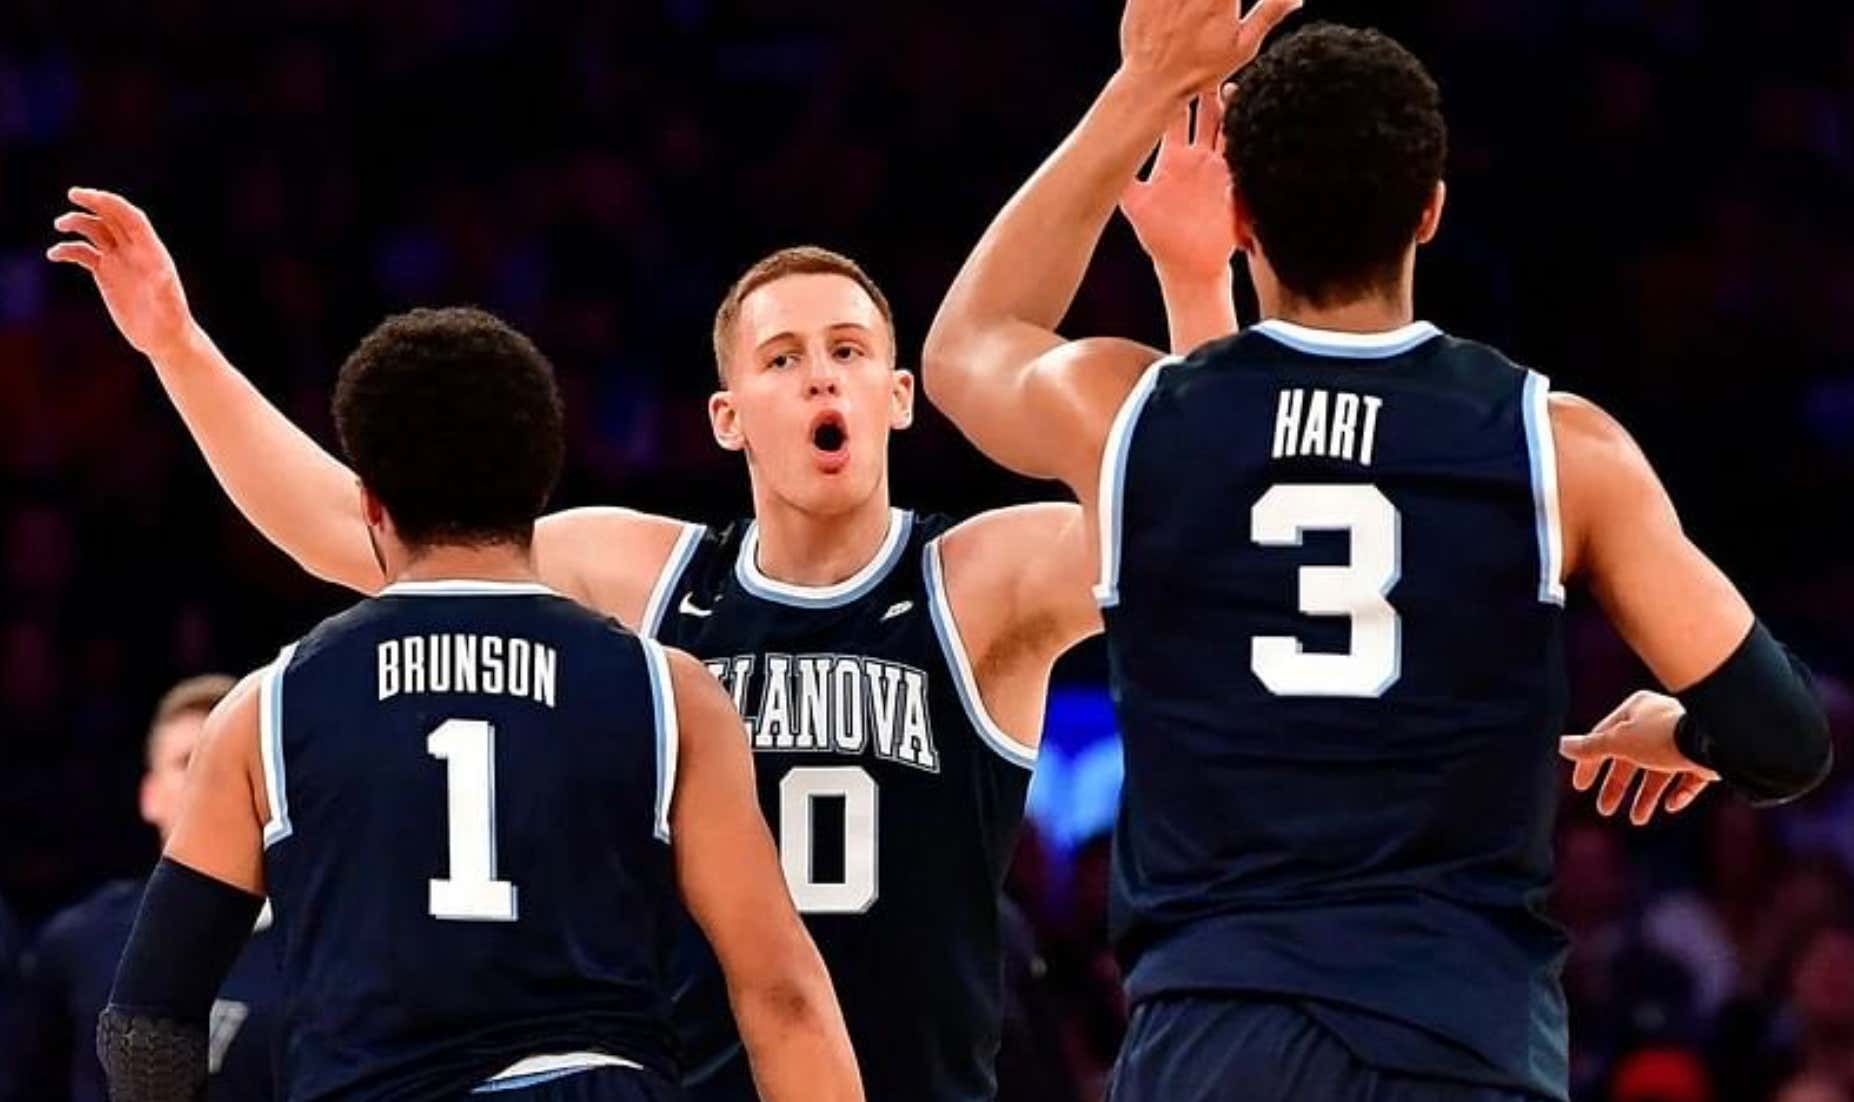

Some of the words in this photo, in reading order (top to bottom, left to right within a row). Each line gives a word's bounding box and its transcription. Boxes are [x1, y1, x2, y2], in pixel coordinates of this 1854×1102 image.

[1272, 388, 1383, 466] HART
[1251, 482, 1402, 698] 3
[377, 634, 557, 709] BRUNSON
[706, 652, 940, 775] LANOVA
[427, 719, 519, 922] 1
